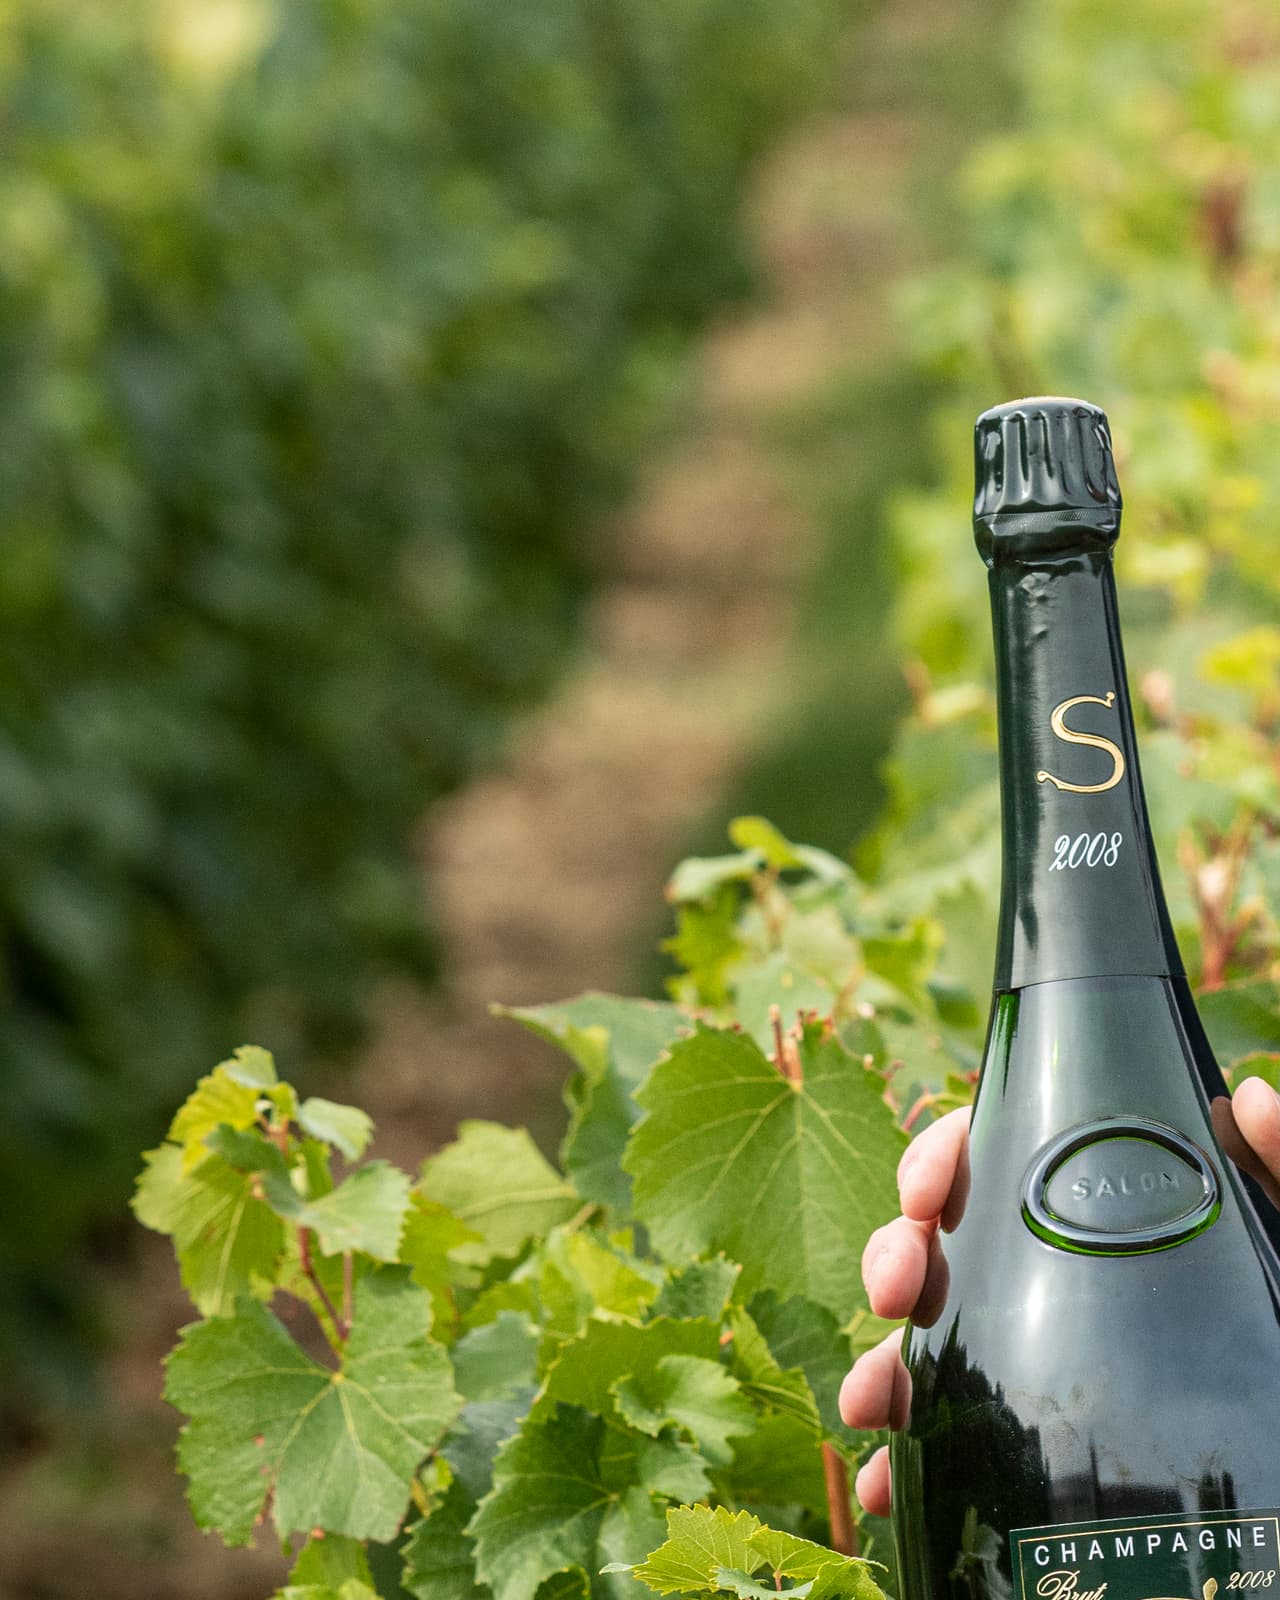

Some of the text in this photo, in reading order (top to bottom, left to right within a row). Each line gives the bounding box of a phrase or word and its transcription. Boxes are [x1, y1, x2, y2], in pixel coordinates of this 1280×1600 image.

[1037, 691, 1126, 794] S
[1048, 832, 1123, 873] 2008
[1034, 1526, 1267, 1567] CHAMPAGNE
[1225, 1569, 1276, 1592] 2008
